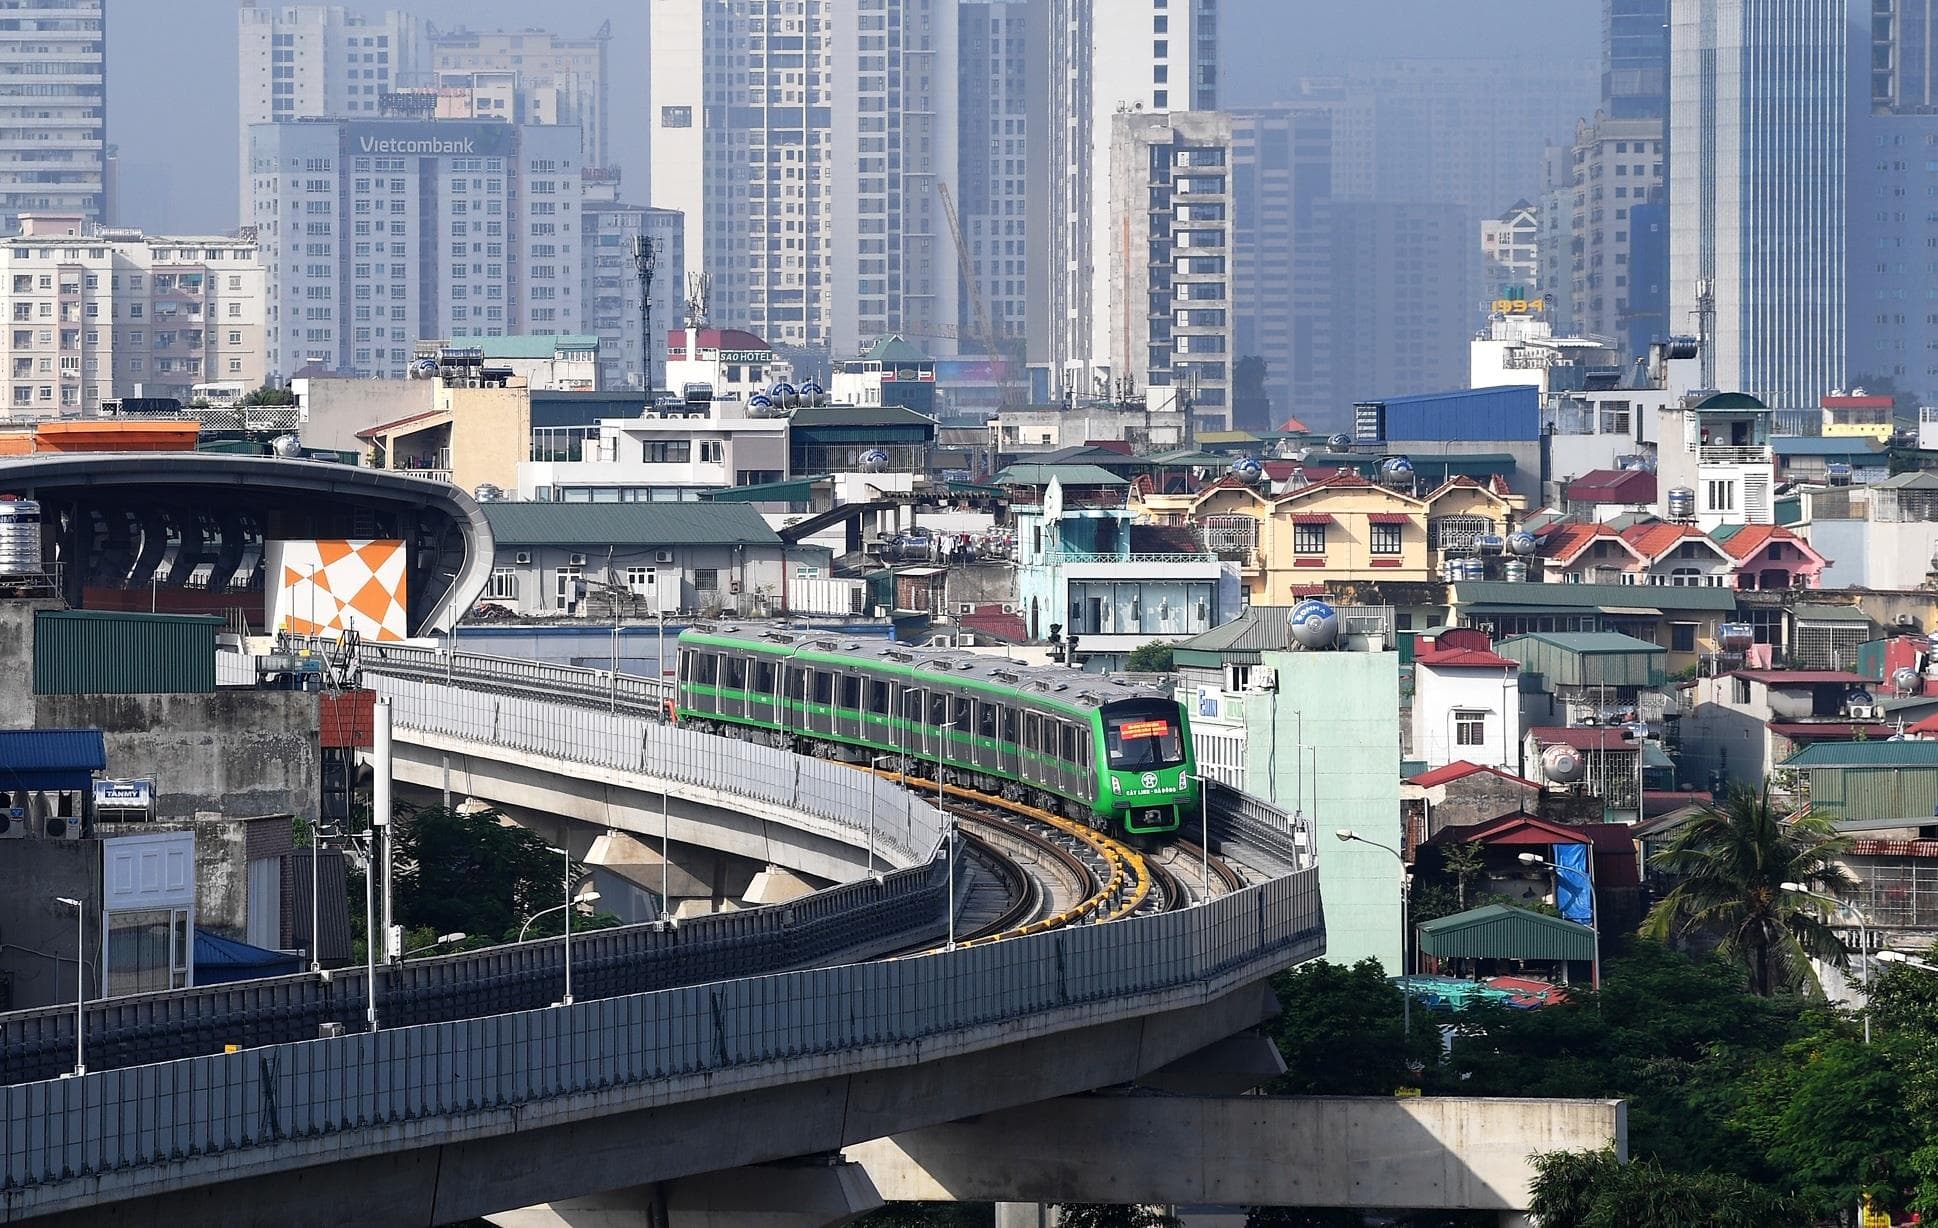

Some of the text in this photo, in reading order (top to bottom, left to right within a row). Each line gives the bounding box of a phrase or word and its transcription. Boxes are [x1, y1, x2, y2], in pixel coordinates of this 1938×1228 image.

[360, 136, 475, 153] Vietcombank
[720, 352, 772, 361] SAO HOTEL
